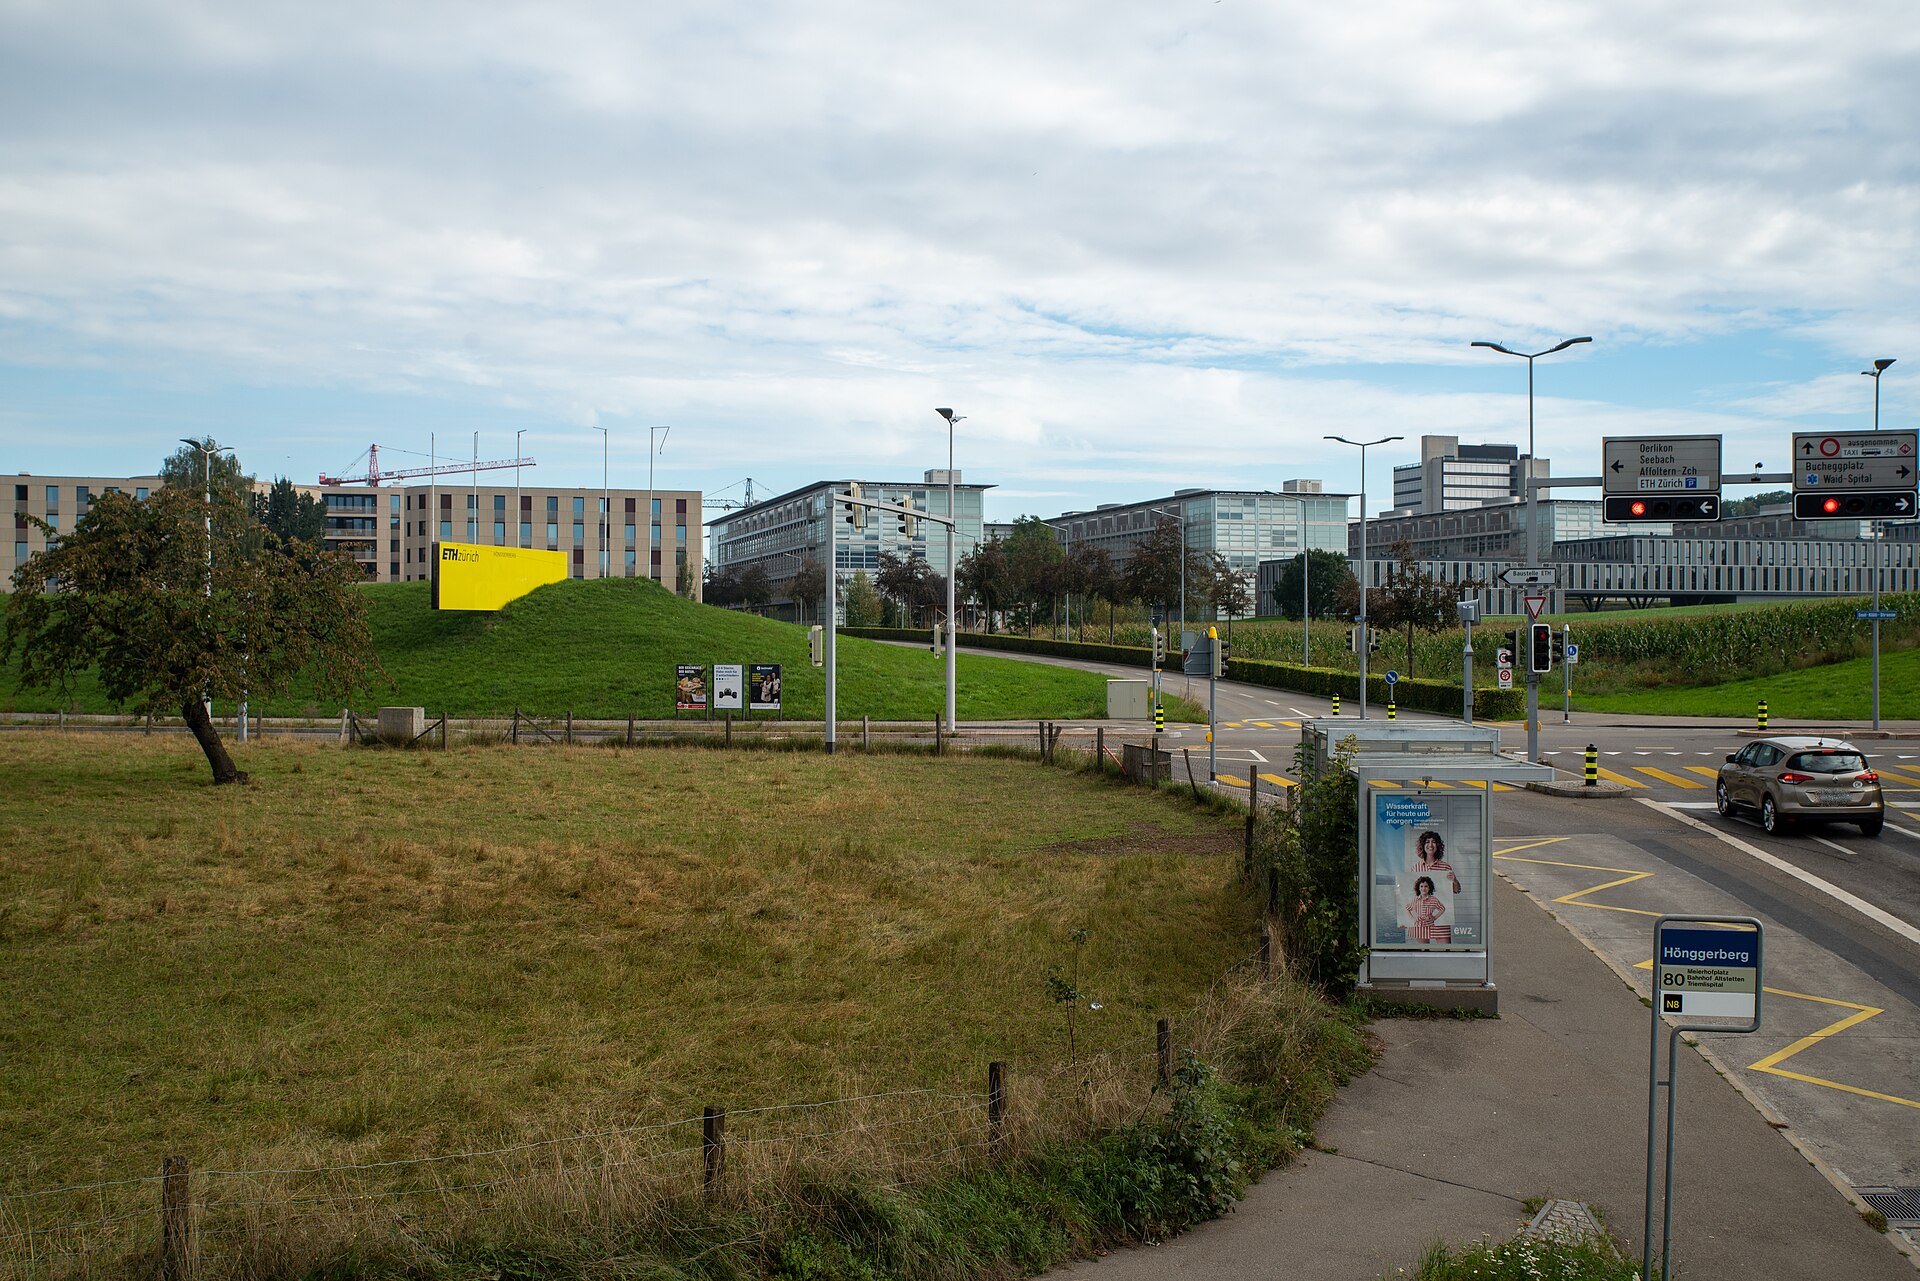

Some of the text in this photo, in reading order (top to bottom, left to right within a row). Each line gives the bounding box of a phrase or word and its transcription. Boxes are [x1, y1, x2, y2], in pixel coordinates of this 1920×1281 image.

[1640, 443, 1673, 453] Oerlikon
[1848, 439, 1898, 447] ausgenommen
[1640, 455, 1675, 464] Seebach
[1805, 461, 1864, 472] Bucheggplatz
[1640, 479, 1656, 488] ETH
[1658, 478, 1683, 488] Zürich
[1453, 926, 1472, 935] ewz
[1664, 947, 1749, 962] Hönggerberg
[1663, 973, 1685, 986] 80
[1666, 1001, 1680, 1009] N8
